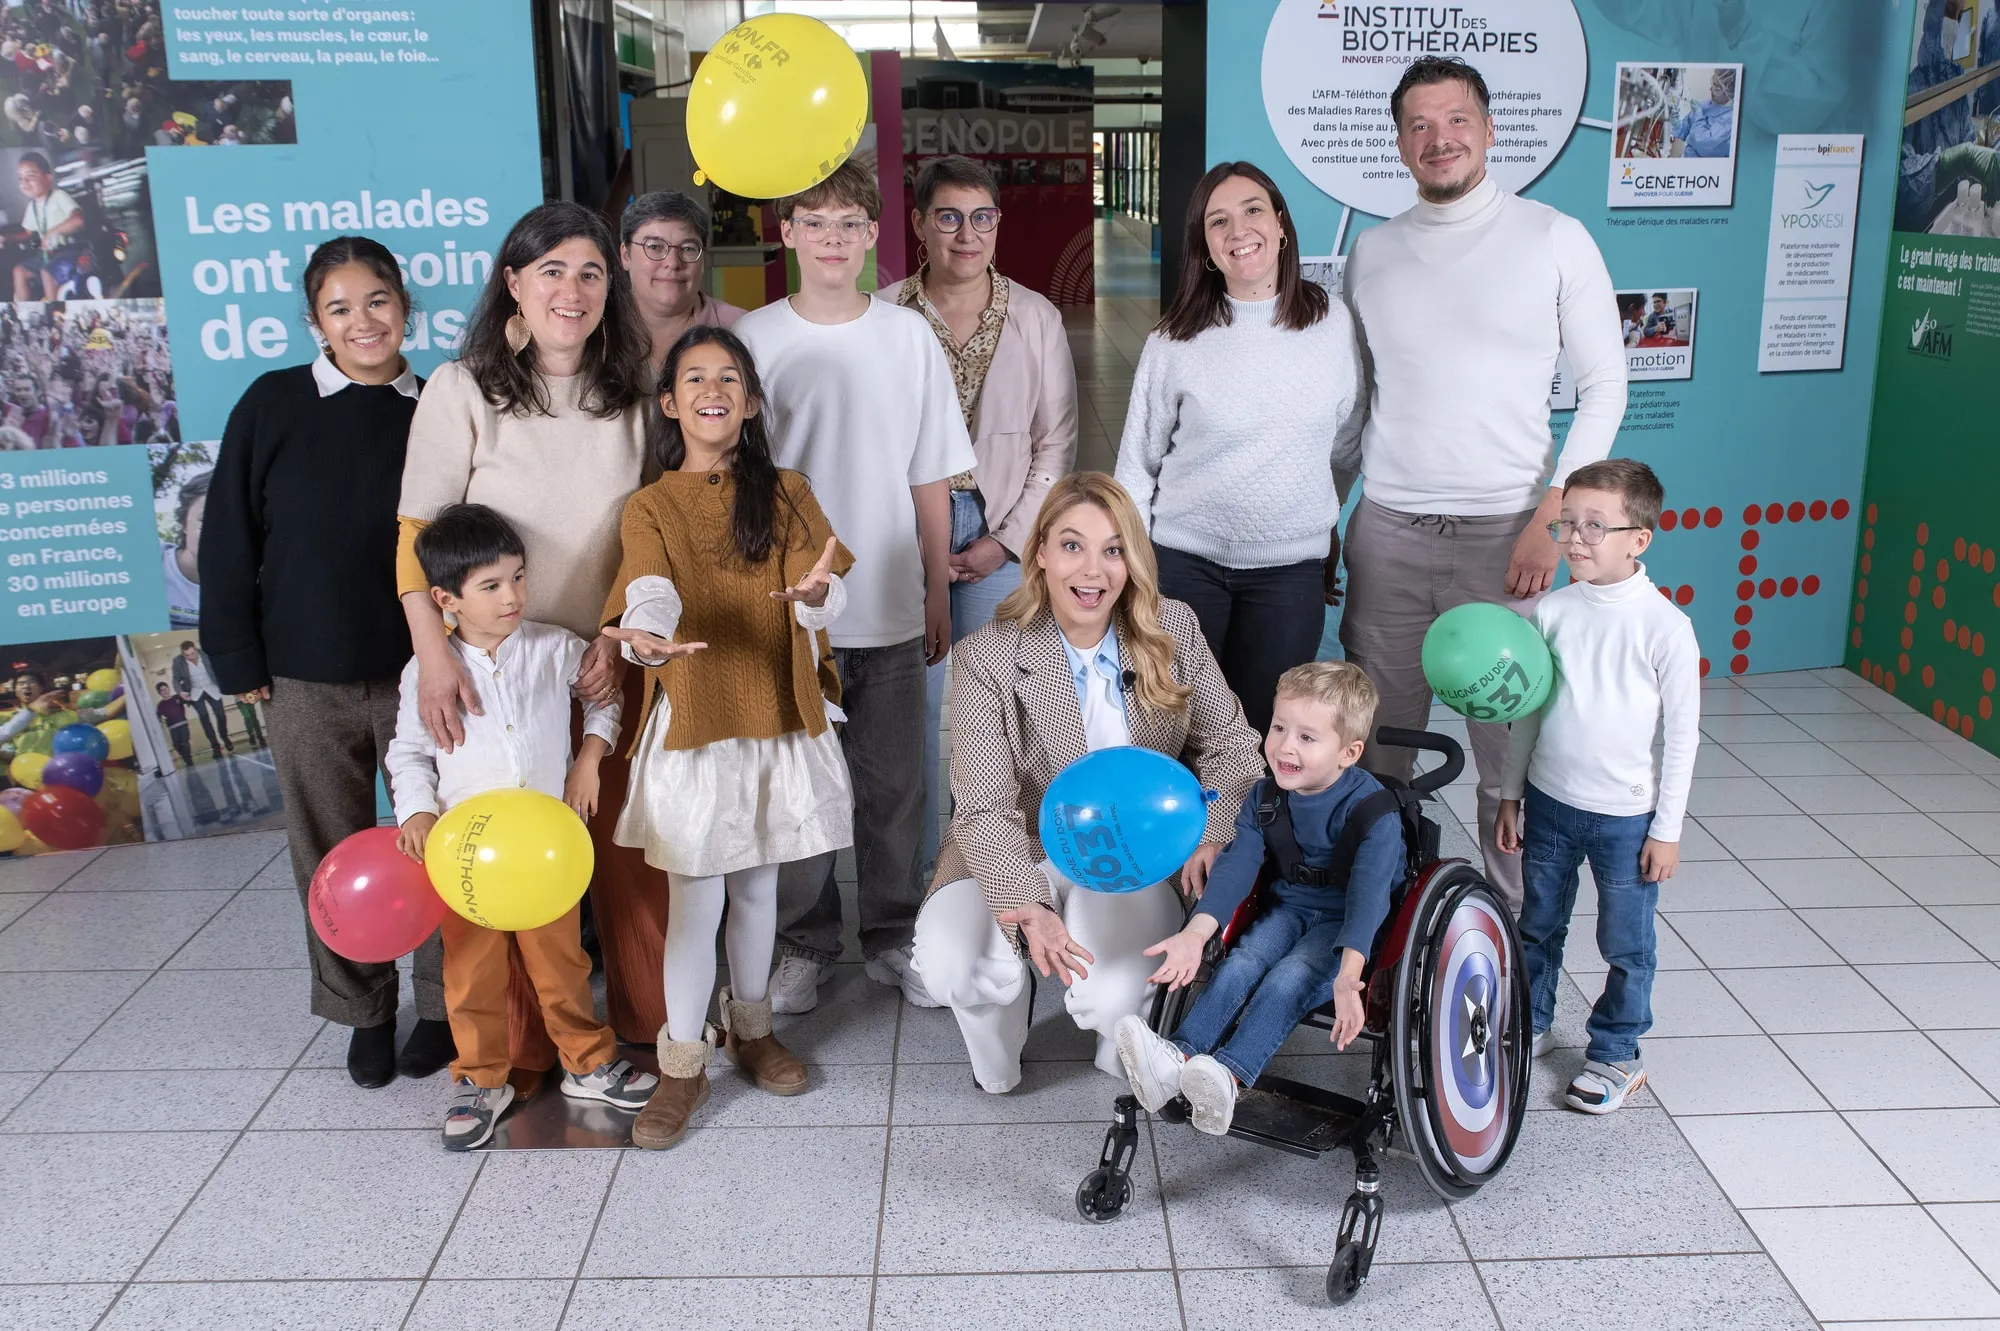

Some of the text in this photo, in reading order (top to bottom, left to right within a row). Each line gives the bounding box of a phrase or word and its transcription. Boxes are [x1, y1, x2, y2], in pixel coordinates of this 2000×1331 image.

[174, 8, 238, 21] toucher
[242, 8, 284, 21] toute
[288, 10, 328, 21] sorte
[1344, 6, 1487, 30] INSTITUT DES
[176, 29, 428, 44] les yeux, les muscles, le cœur, le
[1343, 29, 1538, 53] BIOTHÉRAPIES
[180, 51, 224, 66] sang,
[227, 49, 241, 63] le
[245, 52, 314, 65] cerveau,
[317, 49, 331, 63] la
[335, 51, 377, 65] peau,
[380, 49, 393, 62] le
[1386, 56, 1411, 64] POUR
[1312, 90, 1387, 99] L'AFM-Téléthon
[1288, 106, 1305, 115] des
[1308, 106, 1352, 115] Maladies
[1355, 106, 1382, 115] Rares
[1531, 107, 1562, 118] phares
[1313, 122, 1337, 131] dans
[1340, 122, 1347, 131] la
[1351, 122, 1374, 131] mise
[1301, 138, 1325, 147] Avec
[1328, 138, 1349, 149] près
[1351, 138, 1363, 147] de
[1365, 138, 1386, 147] 500
[1493, 138, 1548, 149] iothérapies
[1818, 144, 1854, 155] bpifrance
[1312, 154, 1358, 163] constitue
[1380, 154, 1401, 163] forc
[1504, 154, 1536, 163] monde
[1396, 170, 1410, 178] les
[1635, 175, 1719, 189] GÉNÉTHON
[185, 188, 490, 234] Les malades
[1607, 218, 1635, 226] Thérapie
[1637, 218, 1664, 226] Génique
[1680, 217, 1709, 225] maladies
[1781, 213, 1843, 228] YPOSKESI
[192, 240, 494, 295] ont soin
[1900, 245, 2000, 273] Le grand virage des traite
[1898, 269, 1962, 296] c'est maintenant !
[200, 304, 288, 361] de
[1922, 329, 1952, 357] AFM
[1630, 390, 1665, 398] Plateforme
[1640, 400, 1680, 410] pédiatriques
[1619, 422, 1674, 431] euromusculaires
[0, 468, 108, 489] 3 millions
[0, 495, 133, 519] e personnes
[0, 518, 128, 542] concernées
[8, 546, 123, 567] en France,
[8, 570, 131, 592] 30 millions
[17, 596, 127, 617] en Europe
[1448, 682, 1480, 699] LIGNE
[1479, 672, 1494, 688] DU
[1494, 655, 1511, 676] DON
[1053, 807, 1064, 834] DON
[1061, 836, 1072, 854] DU
[1066, 855, 1088, 888] LIGNE
